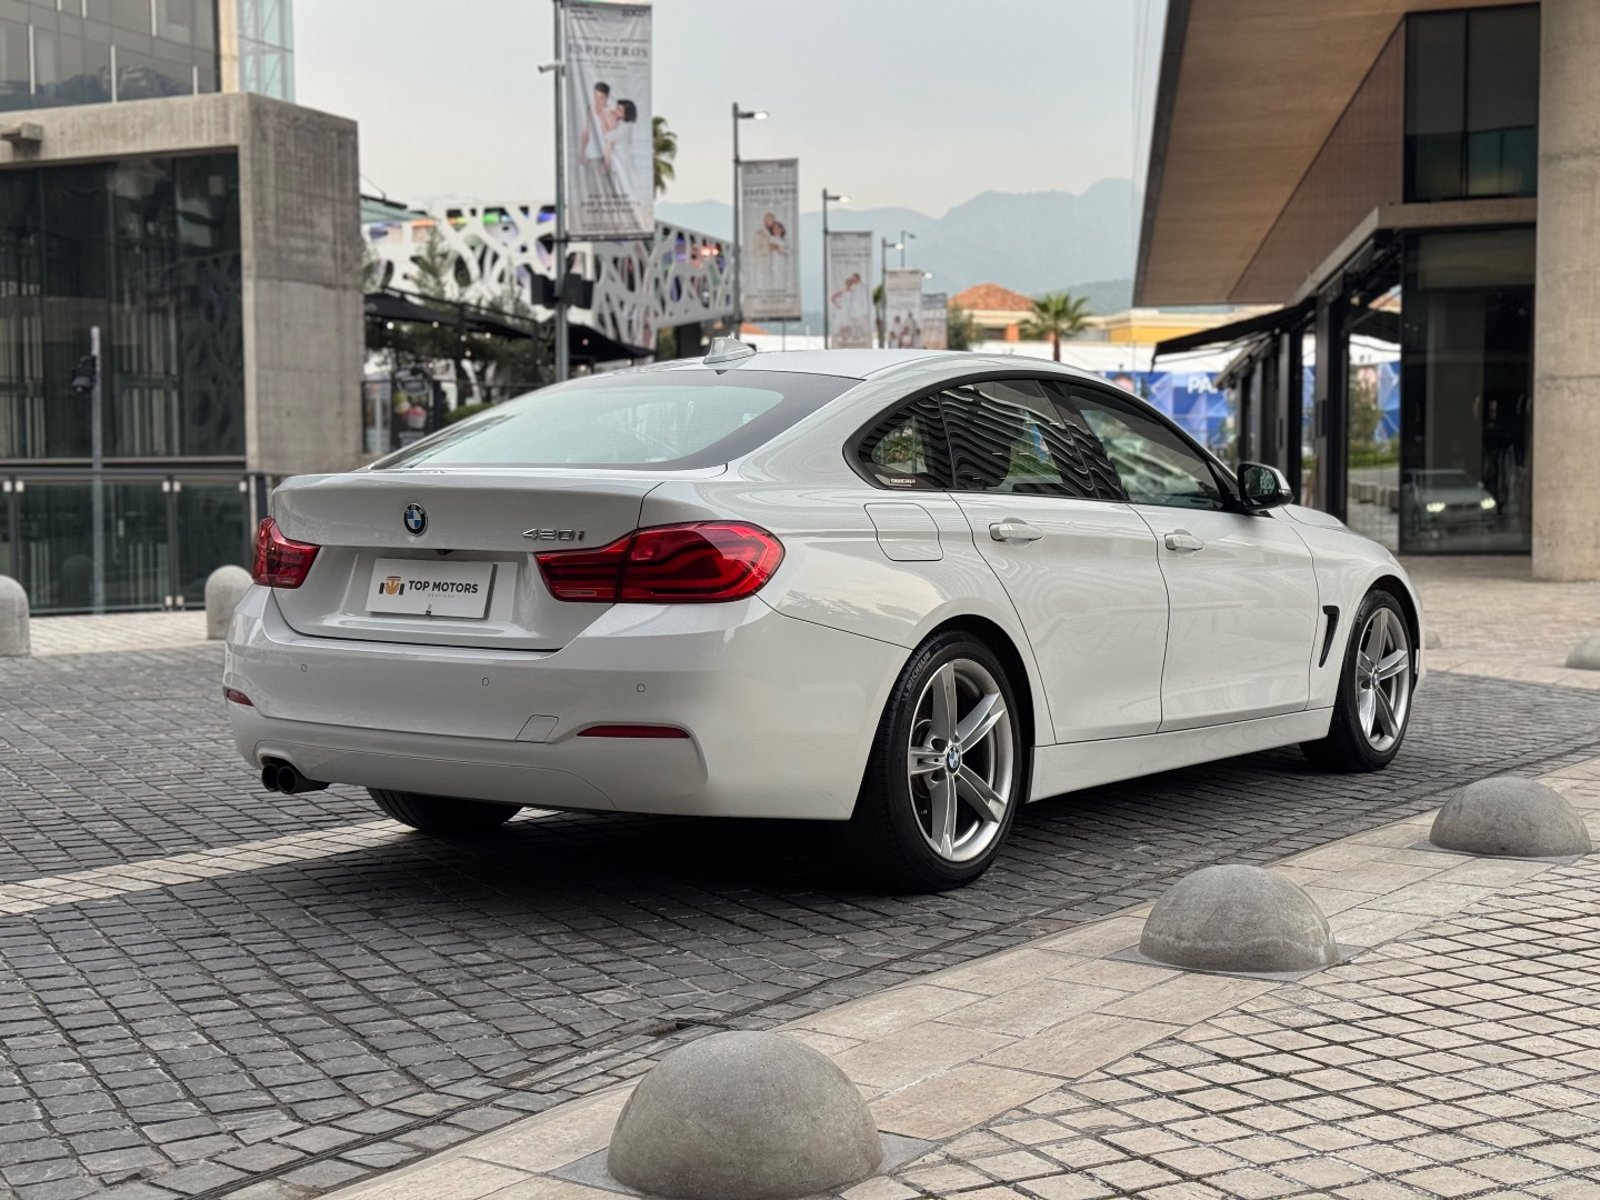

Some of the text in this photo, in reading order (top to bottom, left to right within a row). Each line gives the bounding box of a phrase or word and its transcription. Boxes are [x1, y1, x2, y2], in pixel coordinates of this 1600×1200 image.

[567, 43, 648, 57] ESPECTROS
[408, 580, 479, 594] TOP MOTORS
[906, 650, 931, 692] MICHELIN
